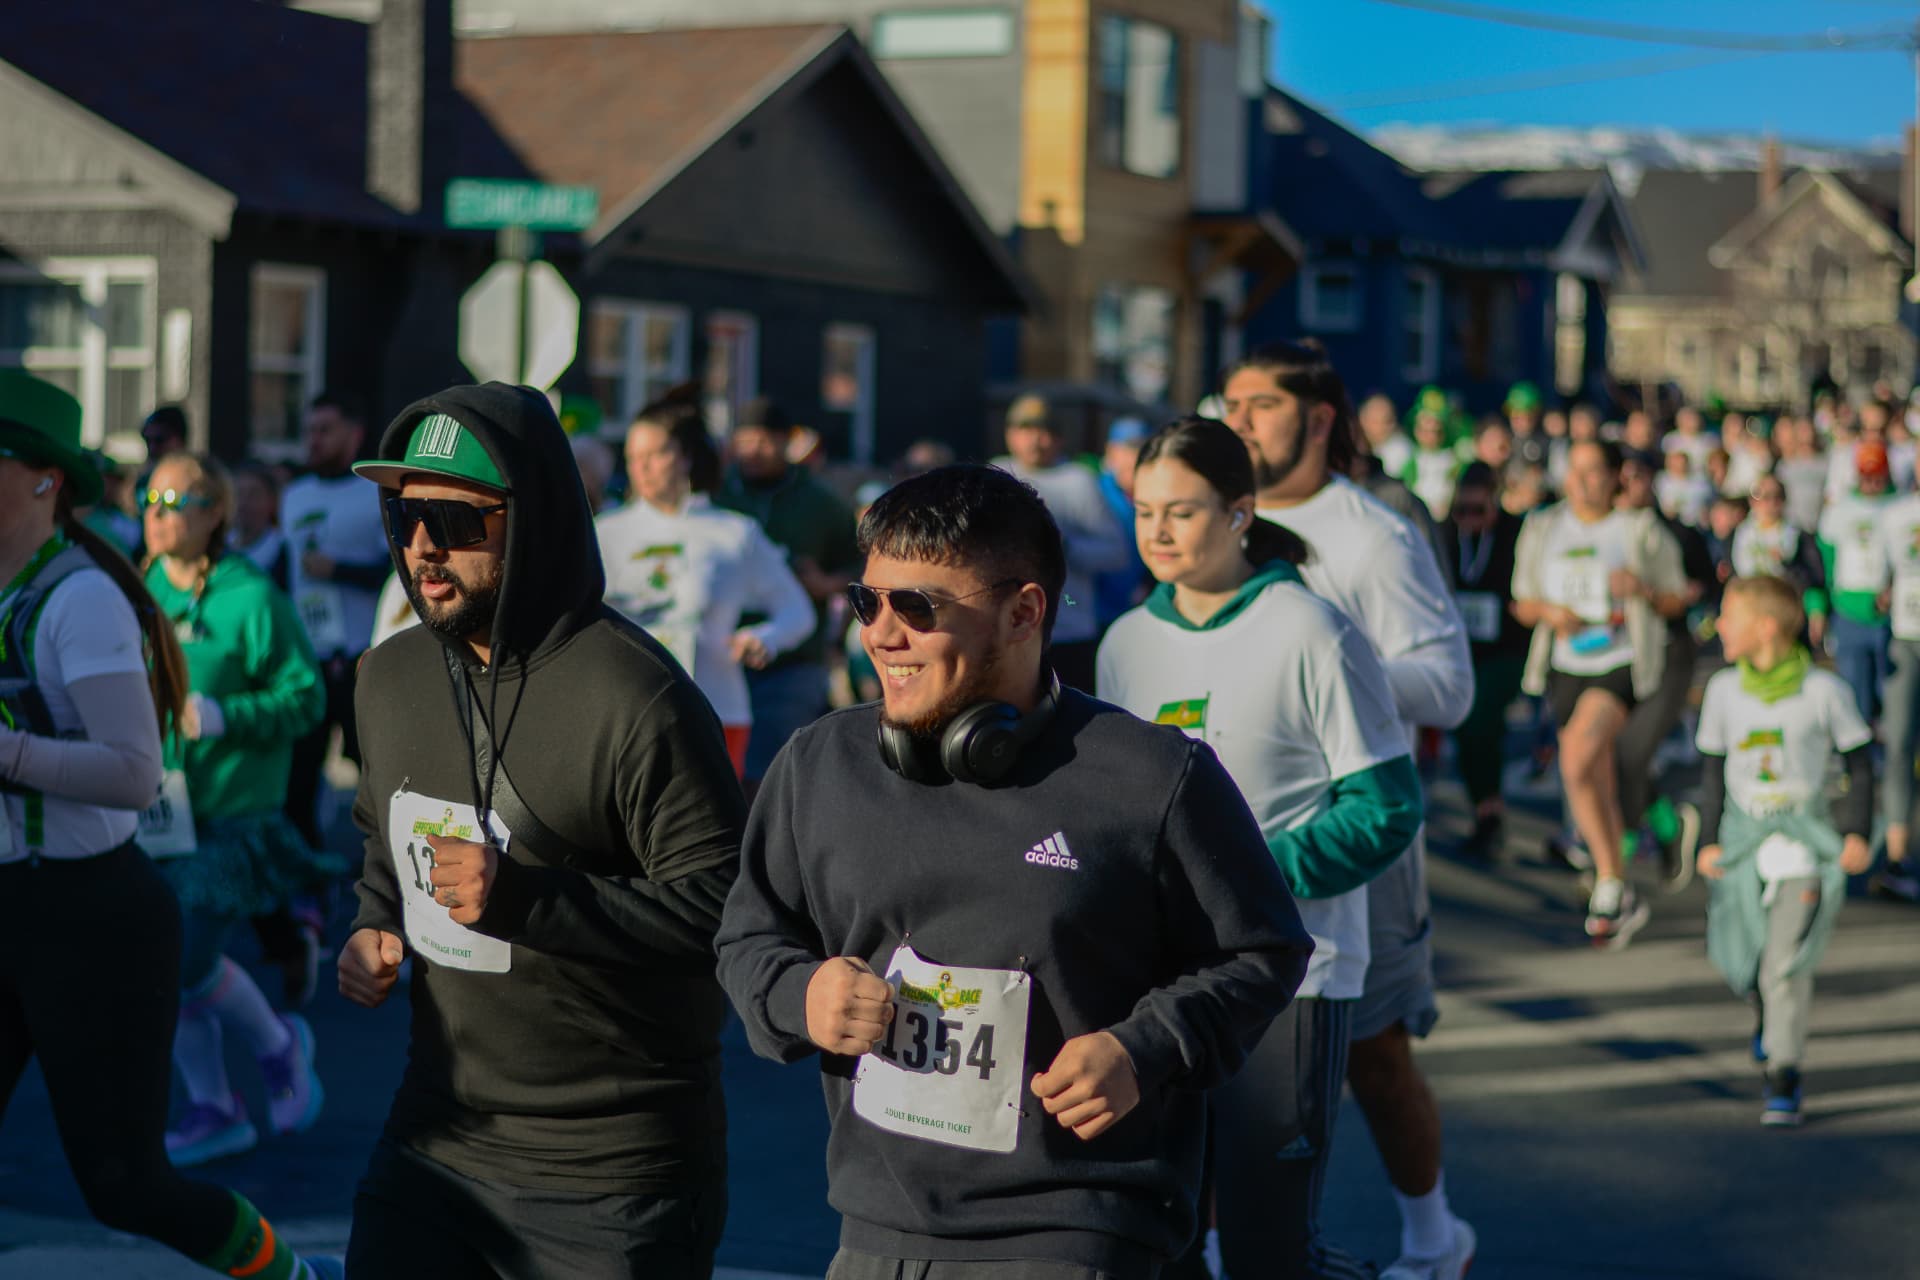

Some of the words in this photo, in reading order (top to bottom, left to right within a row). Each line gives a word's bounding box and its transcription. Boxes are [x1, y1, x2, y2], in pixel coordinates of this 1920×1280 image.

[1025, 851, 1079, 870] adidas
[451, 947, 472, 958] TICKET
[959, 988, 983, 1004] RACE
[881, 1001, 997, 1080] 1354
[884, 1106, 906, 1120] ADULT
[907, 1112, 945, 1129] BEVERAGE
[947, 1121, 972, 1134] TICKET
